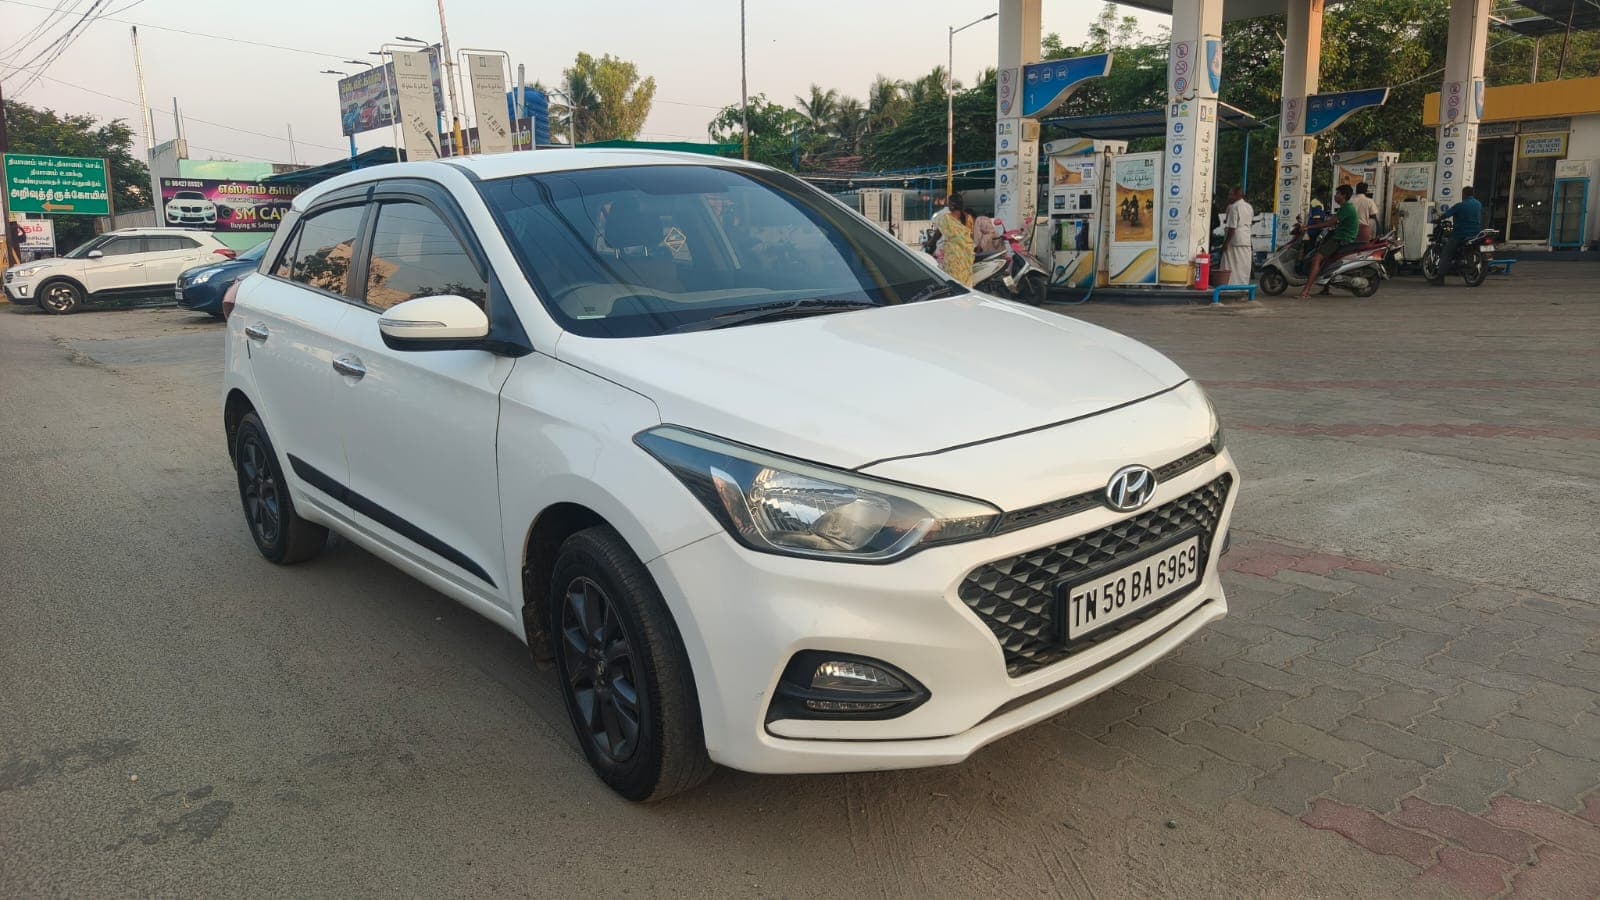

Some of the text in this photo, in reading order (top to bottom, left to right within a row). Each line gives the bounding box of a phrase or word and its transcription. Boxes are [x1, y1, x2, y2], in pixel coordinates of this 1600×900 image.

[1311, 118, 1318, 128] 3
[235, 207, 257, 220] SM
[1072, 545, 1197, 627] TN 58 BA 6969
